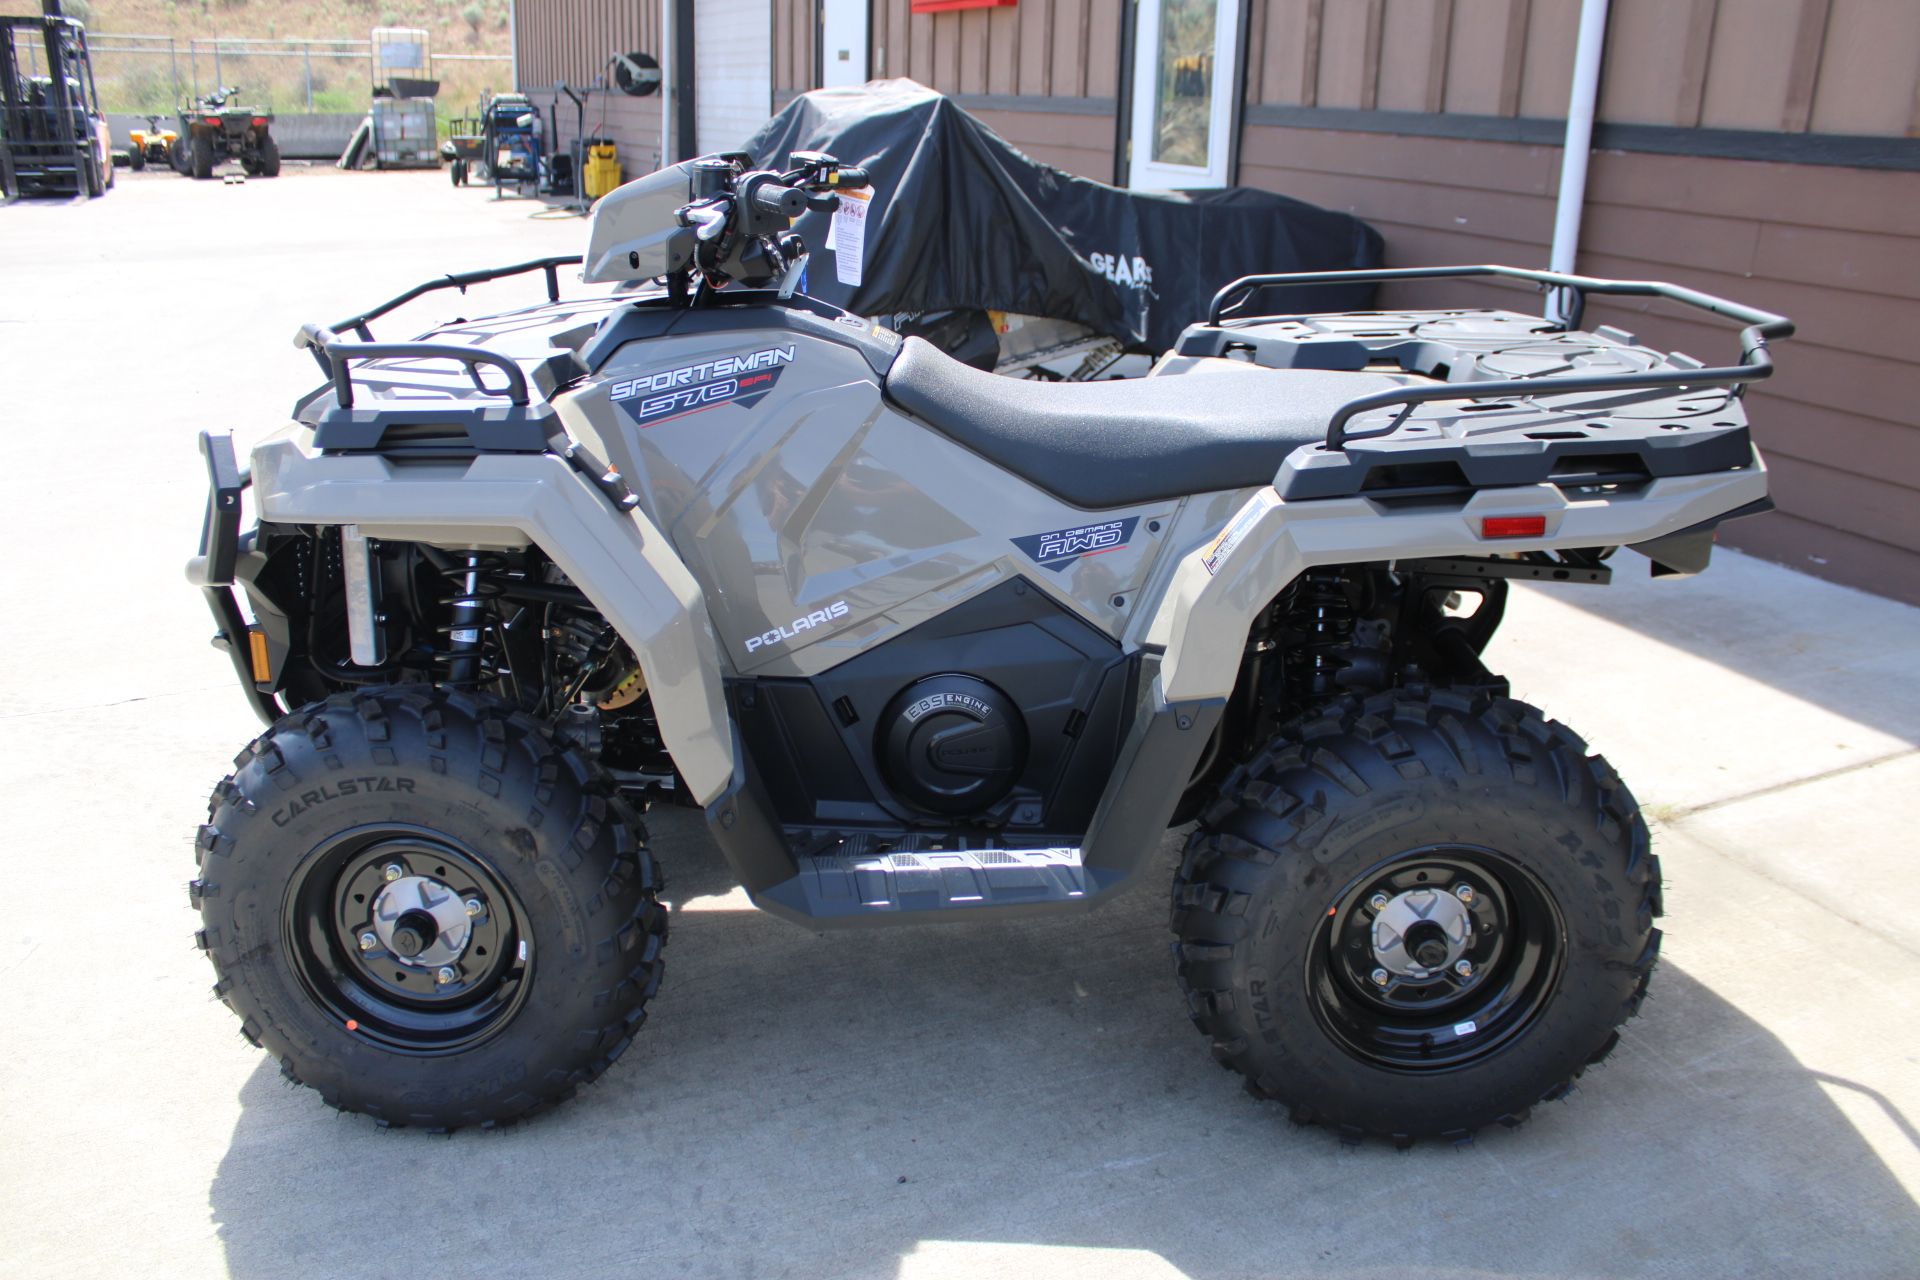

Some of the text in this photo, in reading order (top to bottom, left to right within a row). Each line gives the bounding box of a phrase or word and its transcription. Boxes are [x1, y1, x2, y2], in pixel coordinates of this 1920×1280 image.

[610, 345, 796, 401] SPORTSMAN
[640, 373, 772, 418] 570 EFI
[1038, 528, 1122, 558] AWD
[1041, 521, 1123, 542] ON DEMAND
[744, 600, 849, 653] POLARIS
[907, 695, 942, 719] EBS
[946, 694, 990, 714] ENGINE
[271, 776, 416, 828] CARLSTAR
